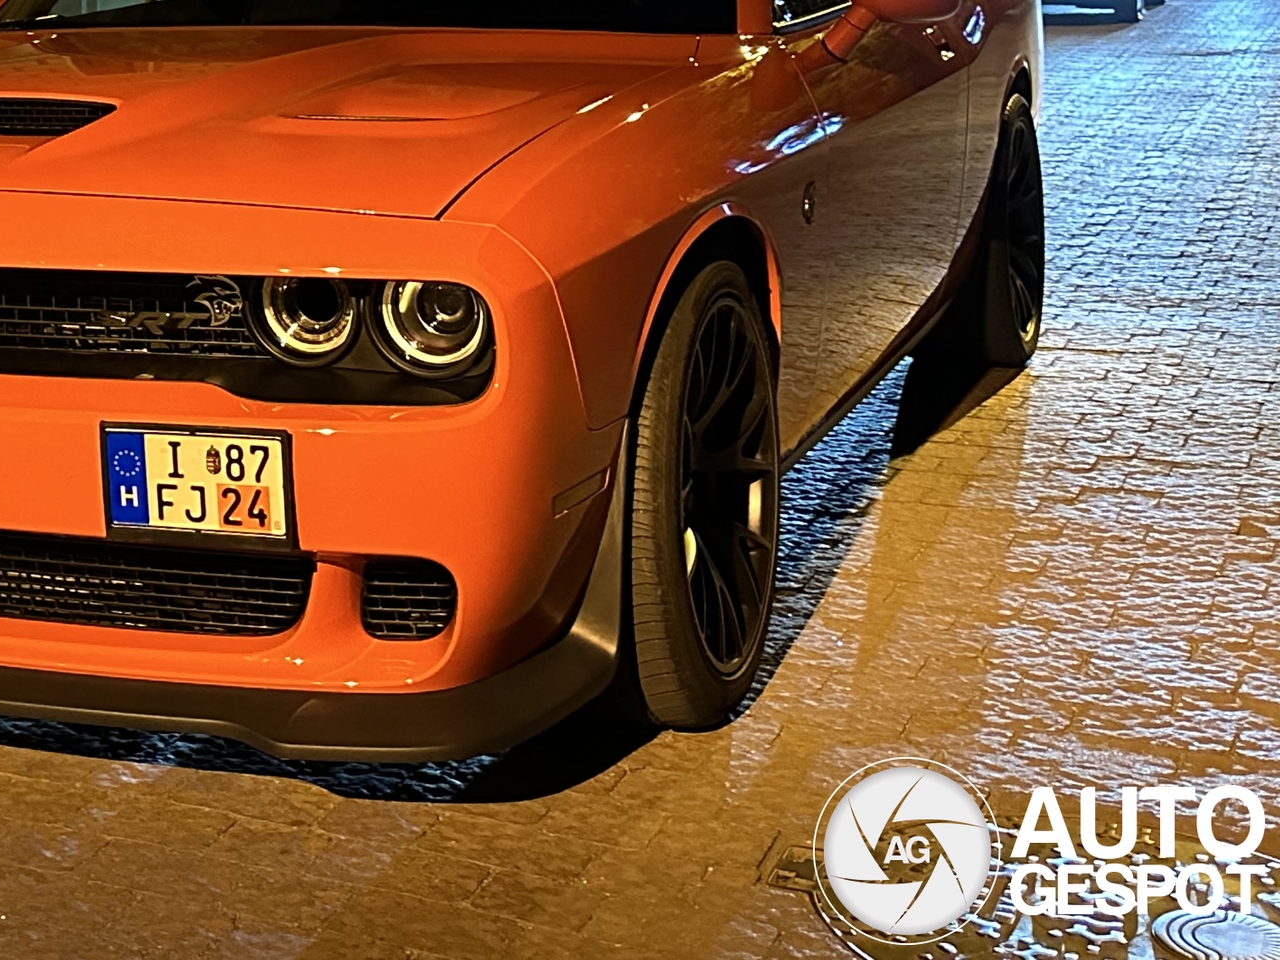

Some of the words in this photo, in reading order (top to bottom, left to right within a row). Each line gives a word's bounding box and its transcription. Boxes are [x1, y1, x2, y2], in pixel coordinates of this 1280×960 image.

[90, 311, 210, 335] SRT
[167, 441, 185, 479] I
[225, 444, 270, 483] 87
[120, 485, 139, 507] H
[156, 483, 207, 523] FJ
[221, 487, 268, 528] 24
